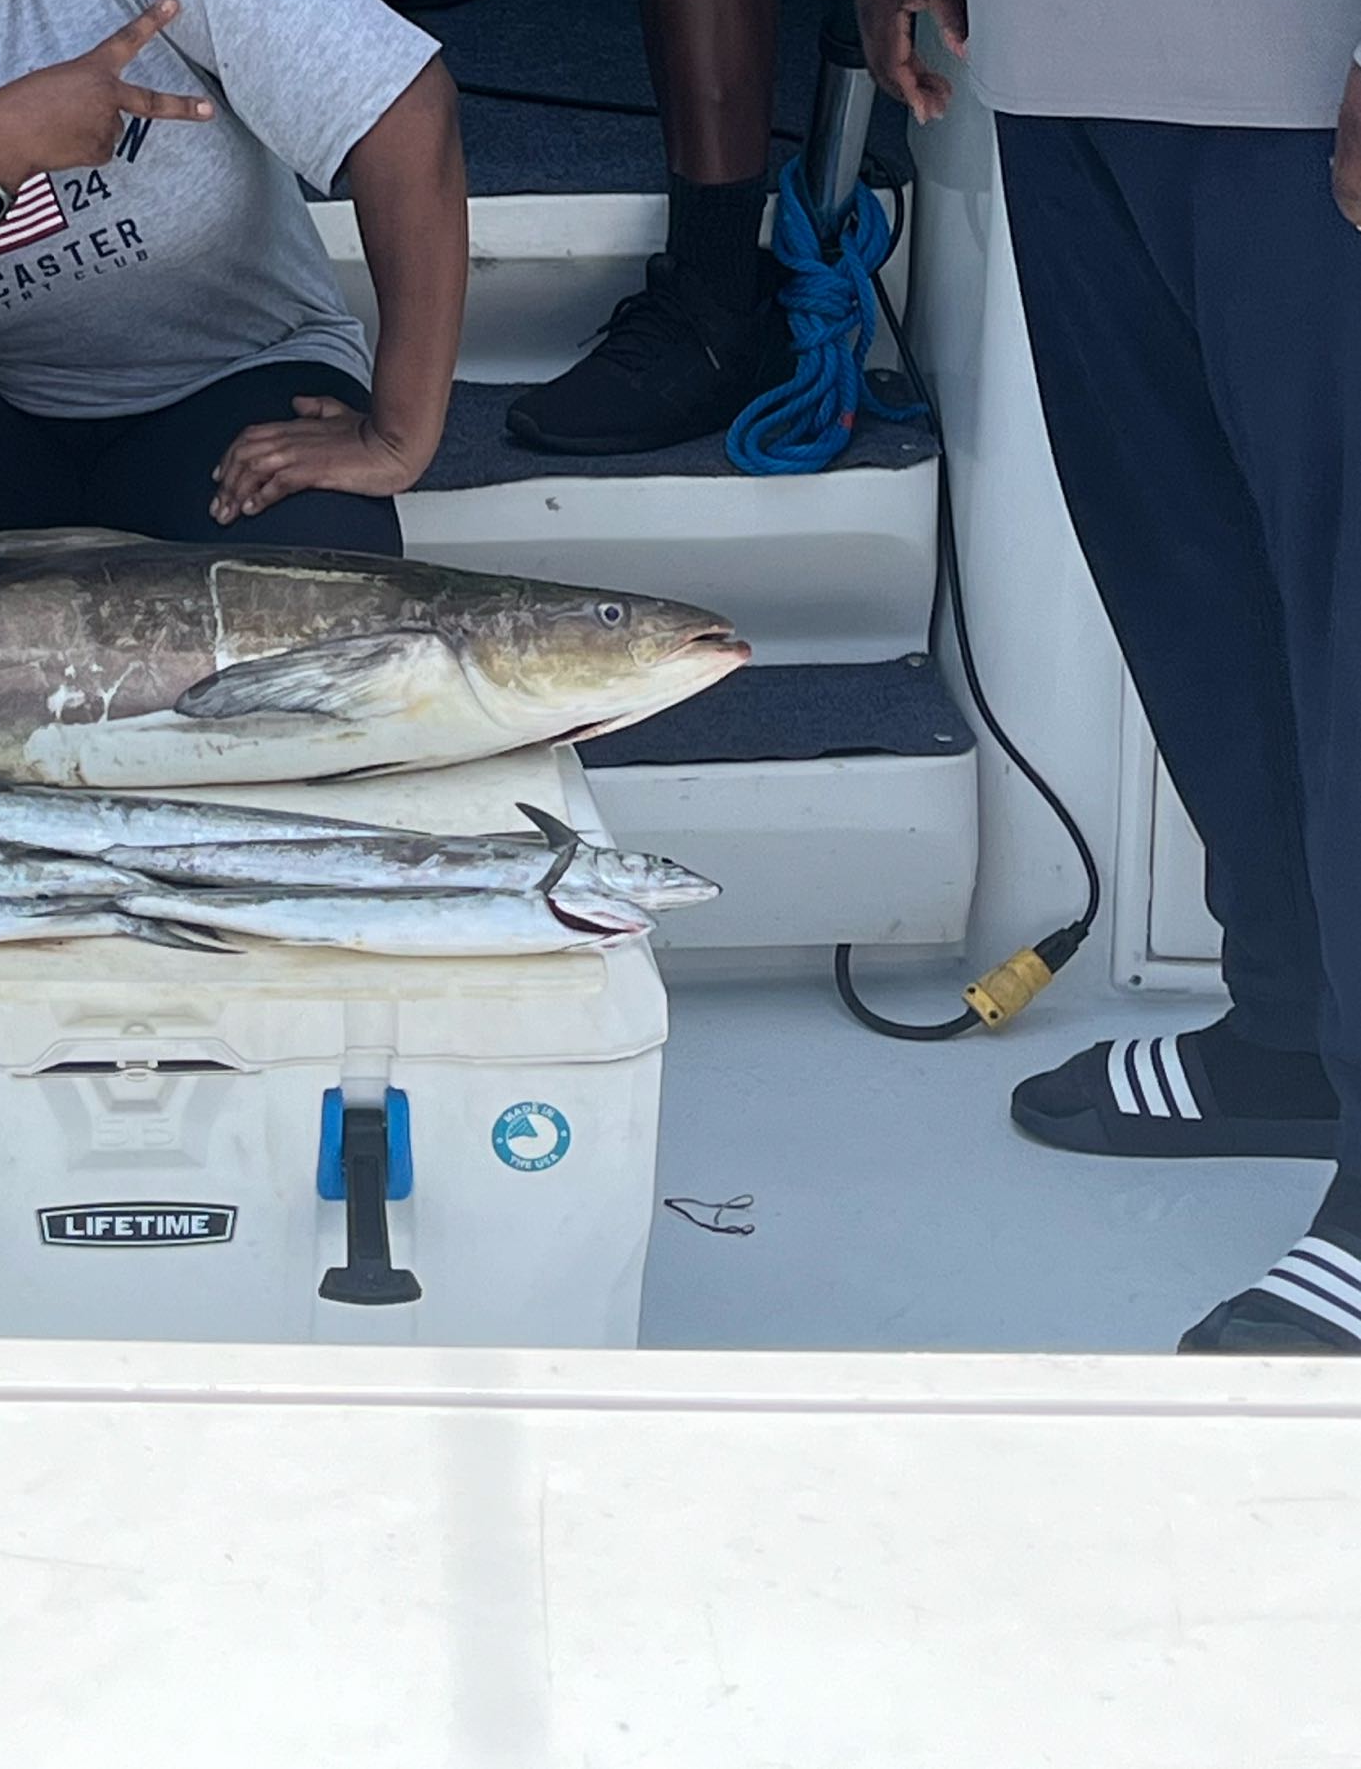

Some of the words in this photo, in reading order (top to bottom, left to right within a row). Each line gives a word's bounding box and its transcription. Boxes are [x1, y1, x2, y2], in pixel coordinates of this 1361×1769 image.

[64, 169, 112, 212] 24
[73, 249, 149, 281] CLUB
[503, 1102, 539, 1123] MADE
[534, 1152, 559, 1169] USA
[65, 1214, 210, 1236] LIFETIME
